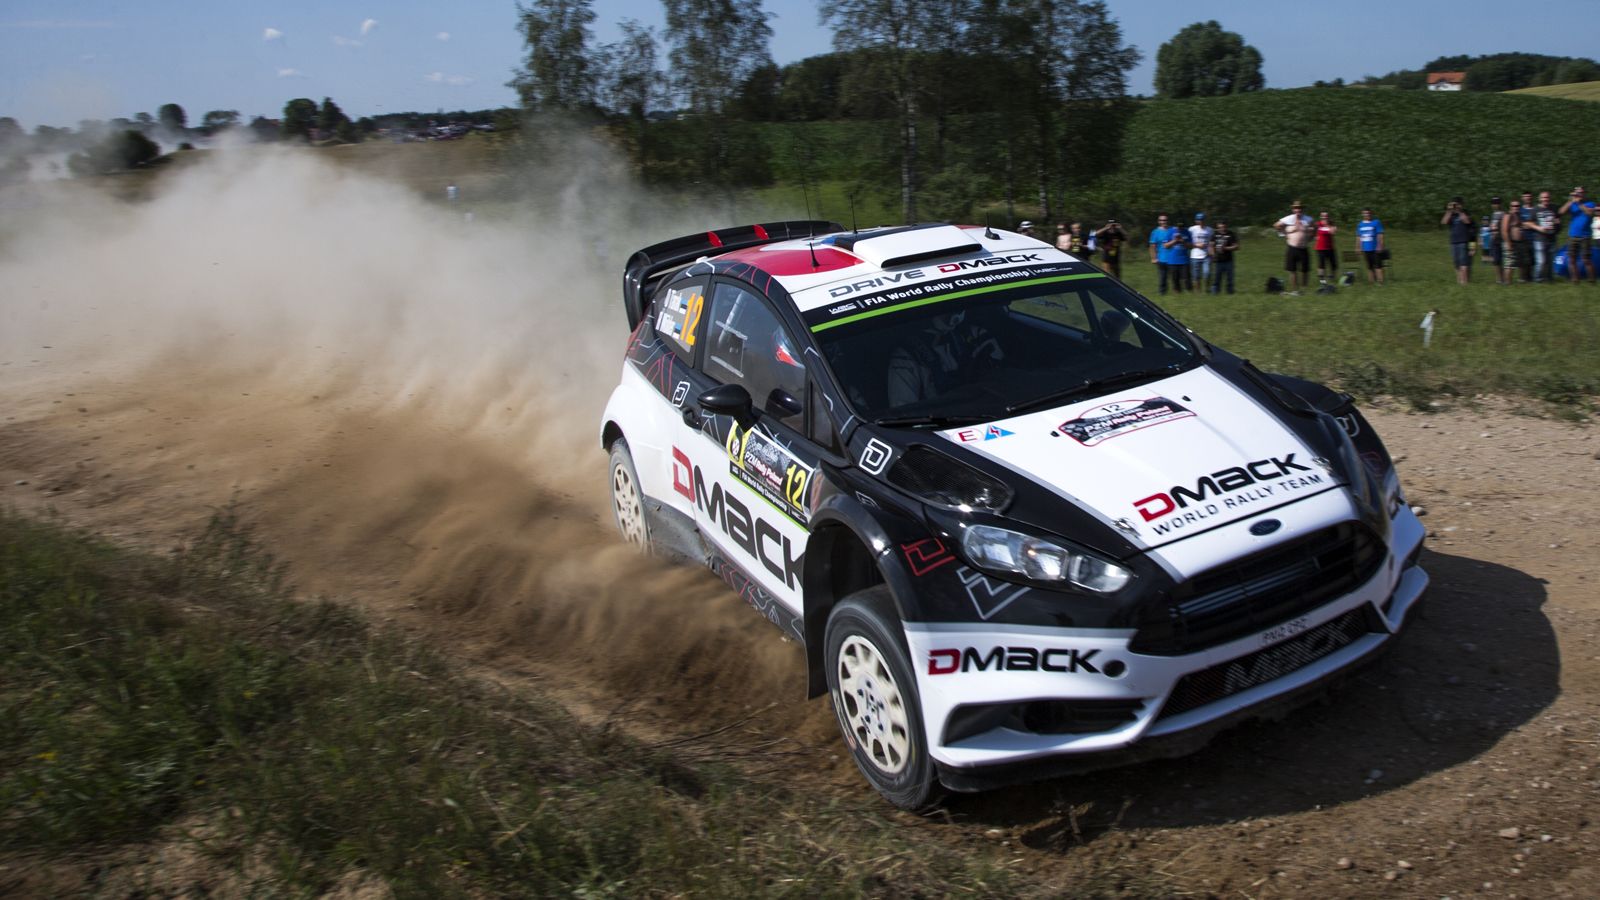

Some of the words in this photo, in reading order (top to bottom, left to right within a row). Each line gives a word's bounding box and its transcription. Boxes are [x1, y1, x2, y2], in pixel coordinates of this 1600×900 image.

[829, 269, 926, 298] DRIVE
[937, 253, 1045, 274] DMACK
[864, 293, 887, 307] FIA
[886, 288, 923, 302] World
[925, 281, 955, 294] Rally
[955, 269, 1030, 287] Championship
[680, 292, 704, 346] 12
[1102, 404, 1125, 413] 12
[786, 463, 807, 512] 12
[1133, 453, 1312, 522] DMACK
[1152, 504, 1220, 536] WORLD
[1223, 485, 1274, 509] RALLY
[1280, 474, 1324, 492] TEAM
[673, 445, 803, 592] DMACK
[928, 646, 1102, 675] DMACK
